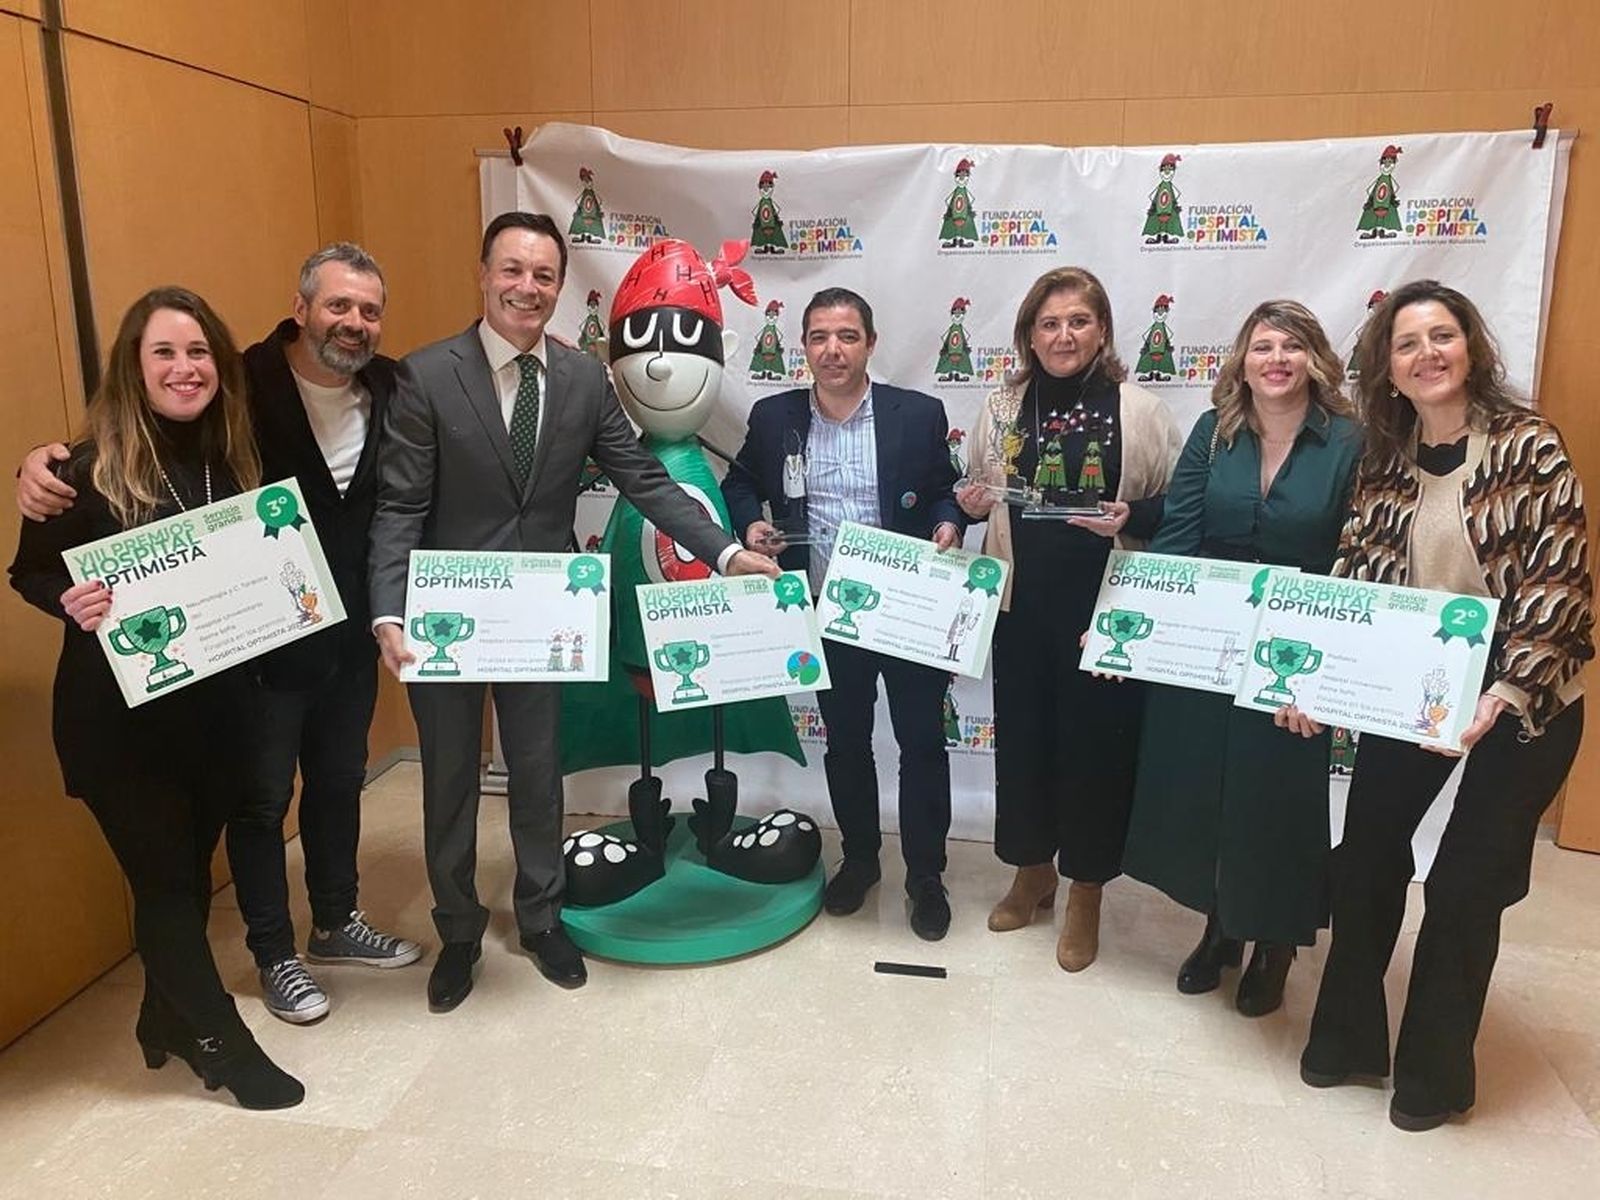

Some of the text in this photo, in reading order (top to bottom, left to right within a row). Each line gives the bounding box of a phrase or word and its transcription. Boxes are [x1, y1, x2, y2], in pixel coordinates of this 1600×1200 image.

[1187, 215, 1259, 229] HOSPITAL
[1405, 208, 1479, 223] HOSPITAL
[789, 227, 855, 241] HOSPITAL
[981, 219, 1049, 233] HOSPITAL
[1405, 222, 1487, 236] OPTIMISTA
[981, 233, 1057, 247] OPTIMISTA
[1187, 228, 1268, 242] OPTIMISTA
[790, 239, 863, 253] OPTIMISTA
[977, 356, 1016, 369] HOSPI
[207, 515, 243, 532] grande
[112, 520, 194, 556] PREMIOS
[80, 530, 201, 580] HOSPITAL
[842, 533, 922, 564] HOSPITAL
[102, 545, 207, 589] PTIMISTA
[839, 545, 919, 574] OPTIMISTA
[416, 564, 513, 577] HOSPITAL
[1112, 562, 1199, 584] HOSPITAL
[415, 576, 513, 589] OPTIMISTA
[1108, 575, 1195, 595] OPTIMISTA
[1304, 580, 1379, 599] PREMIOS
[645, 590, 730, 609] HOSPITAL
[1271, 584, 1376, 612] HOSPITAL
[647, 603, 732, 621] OPTIMISTA
[1268, 598, 1372, 625] OPTIMISTA
[1388, 602, 1426, 613] grande
